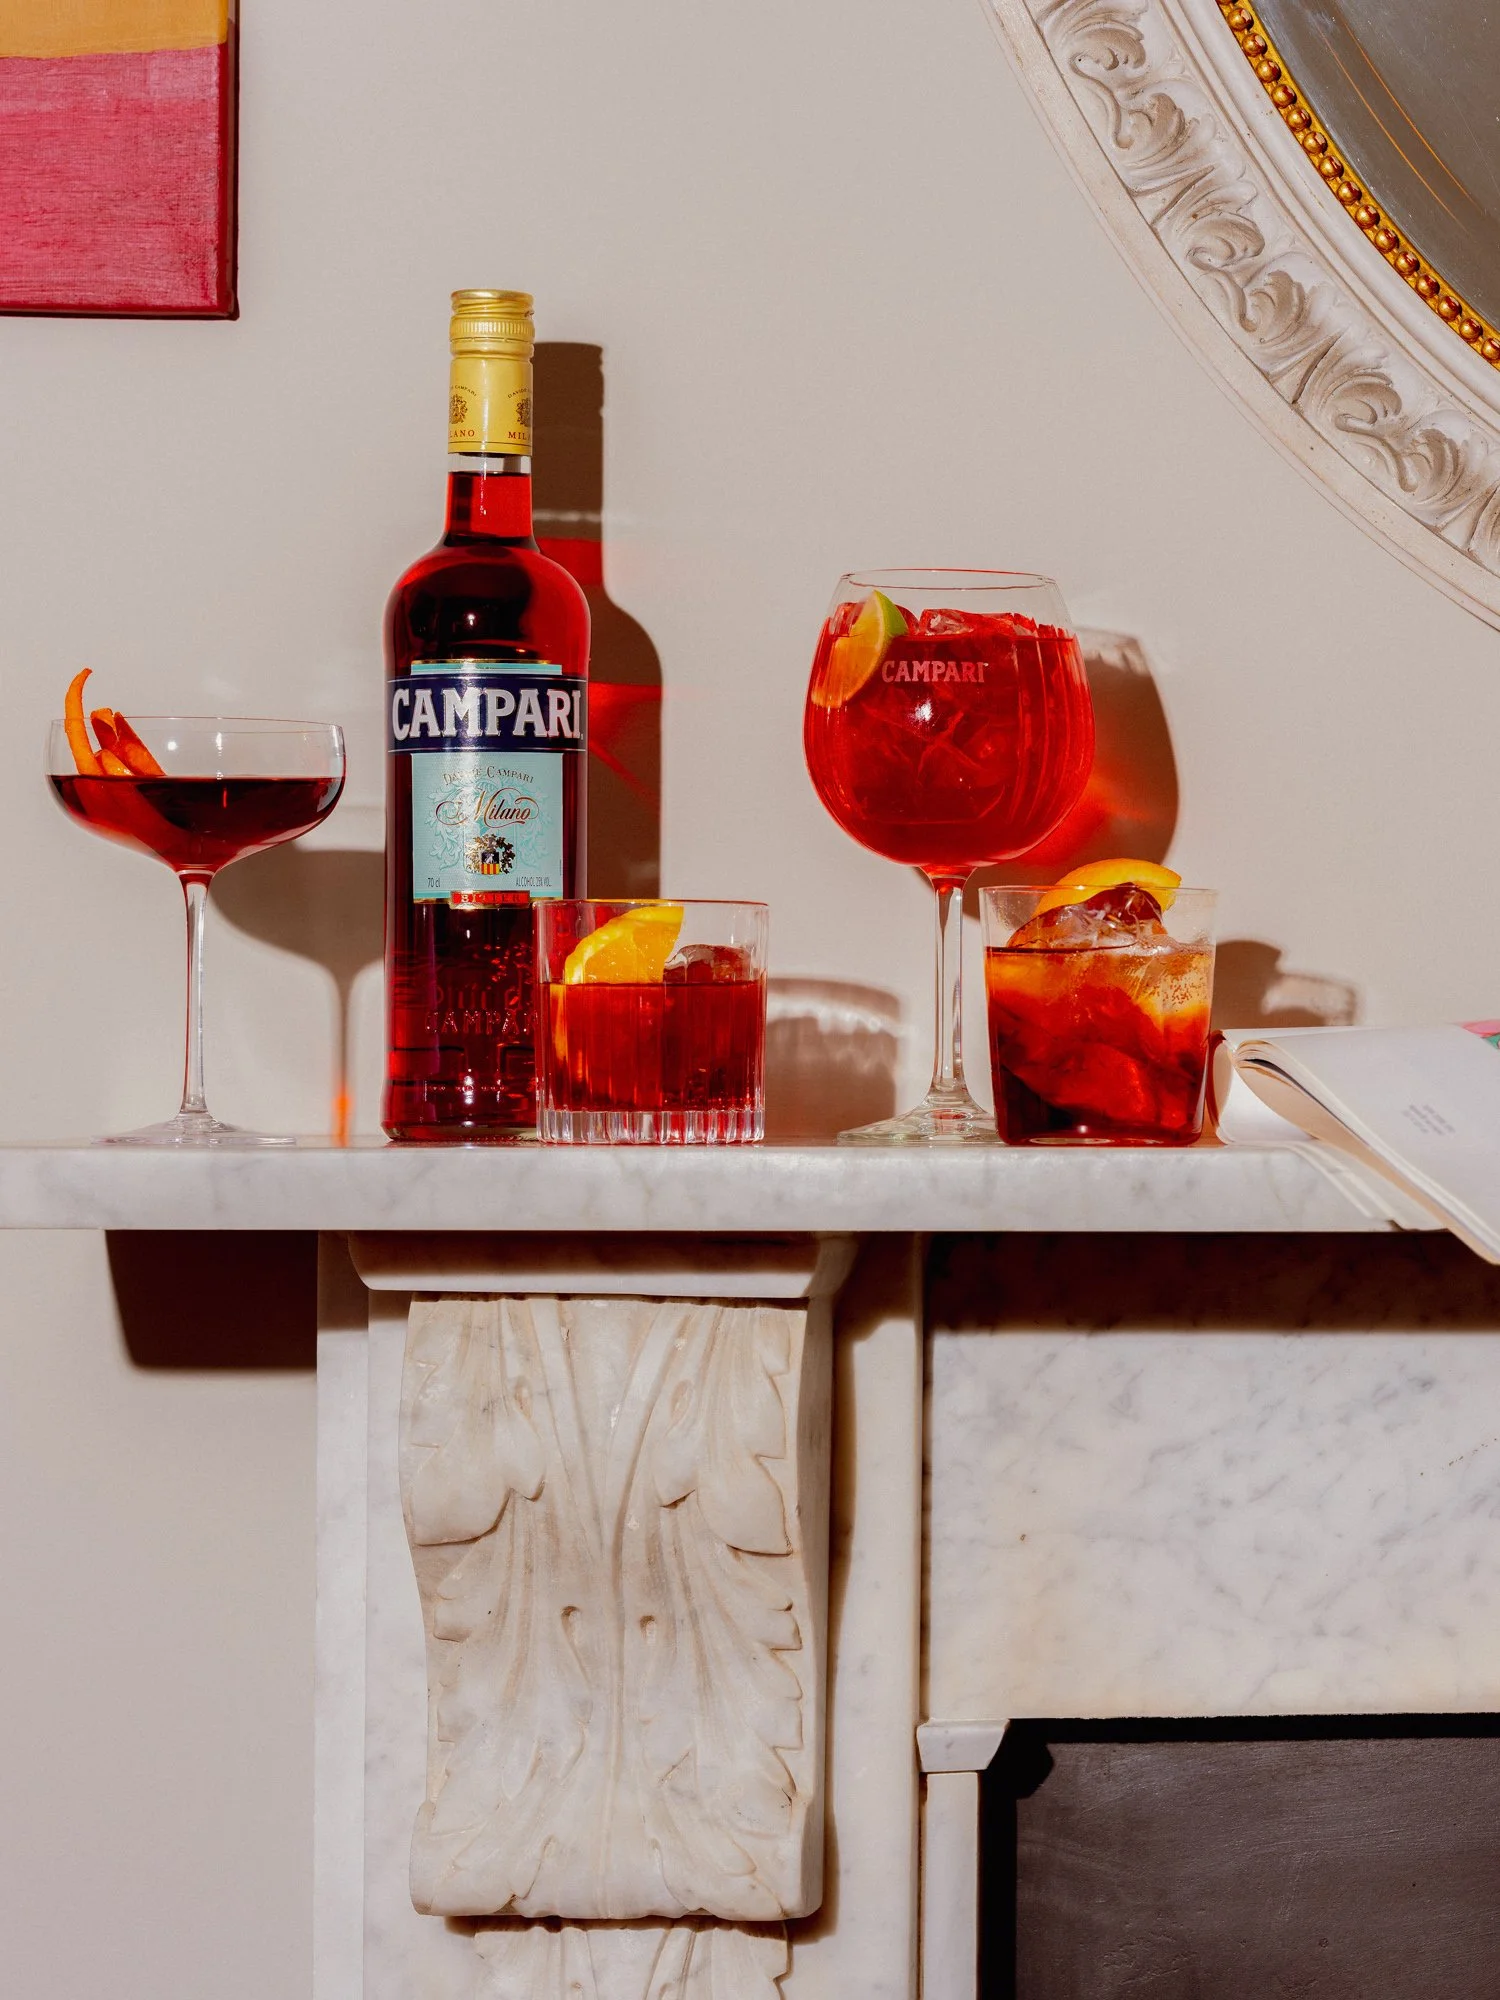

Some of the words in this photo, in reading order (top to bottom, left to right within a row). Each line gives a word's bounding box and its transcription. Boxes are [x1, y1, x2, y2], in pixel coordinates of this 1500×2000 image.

[881, 660, 985, 683] CAMPARI
[392, 687, 581, 741] CAMPARI
[436, 787, 539, 828] Milano
[425, 1010, 533, 1035] CAMPAR
